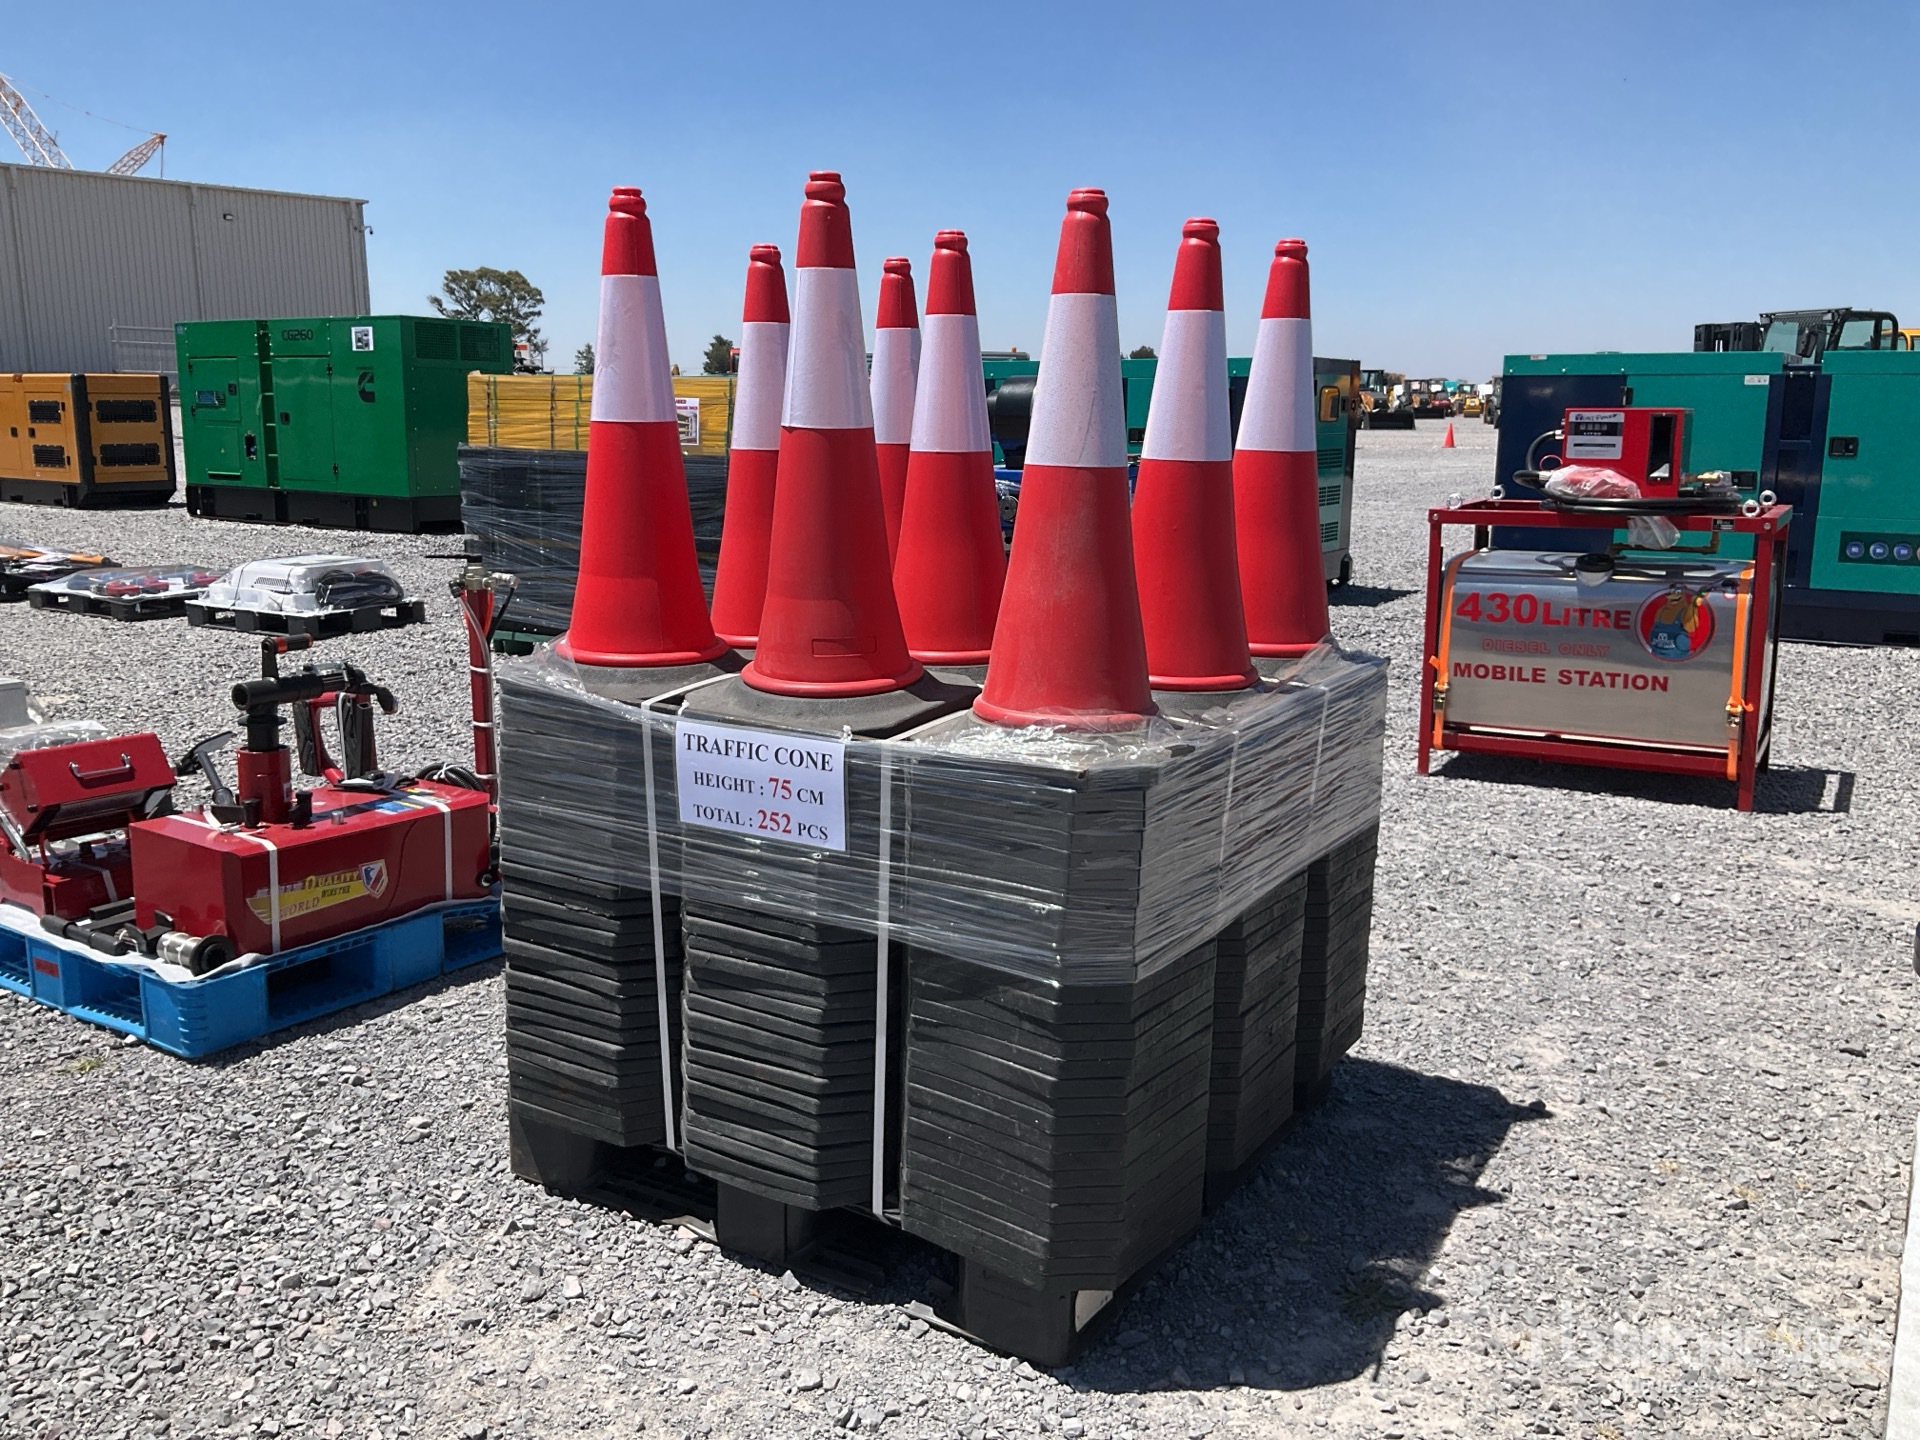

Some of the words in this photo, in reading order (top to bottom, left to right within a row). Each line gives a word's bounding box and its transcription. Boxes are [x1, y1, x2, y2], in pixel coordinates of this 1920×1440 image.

[282, 329, 314, 341] CG260
[1482, 638, 1550, 654] DIESEL
[1559, 642, 1610, 657] ONLY
[1453, 662, 1546, 683] MOBILE
[1557, 669, 1669, 692] STATION
[683, 732, 769, 762] TRAFFIC
[774, 747, 833, 772] CONE
[768, 777, 792, 800] 75
[796, 788, 824, 806] CM
[757, 809, 792, 834] 252
[797, 822, 828, 841] PCS
